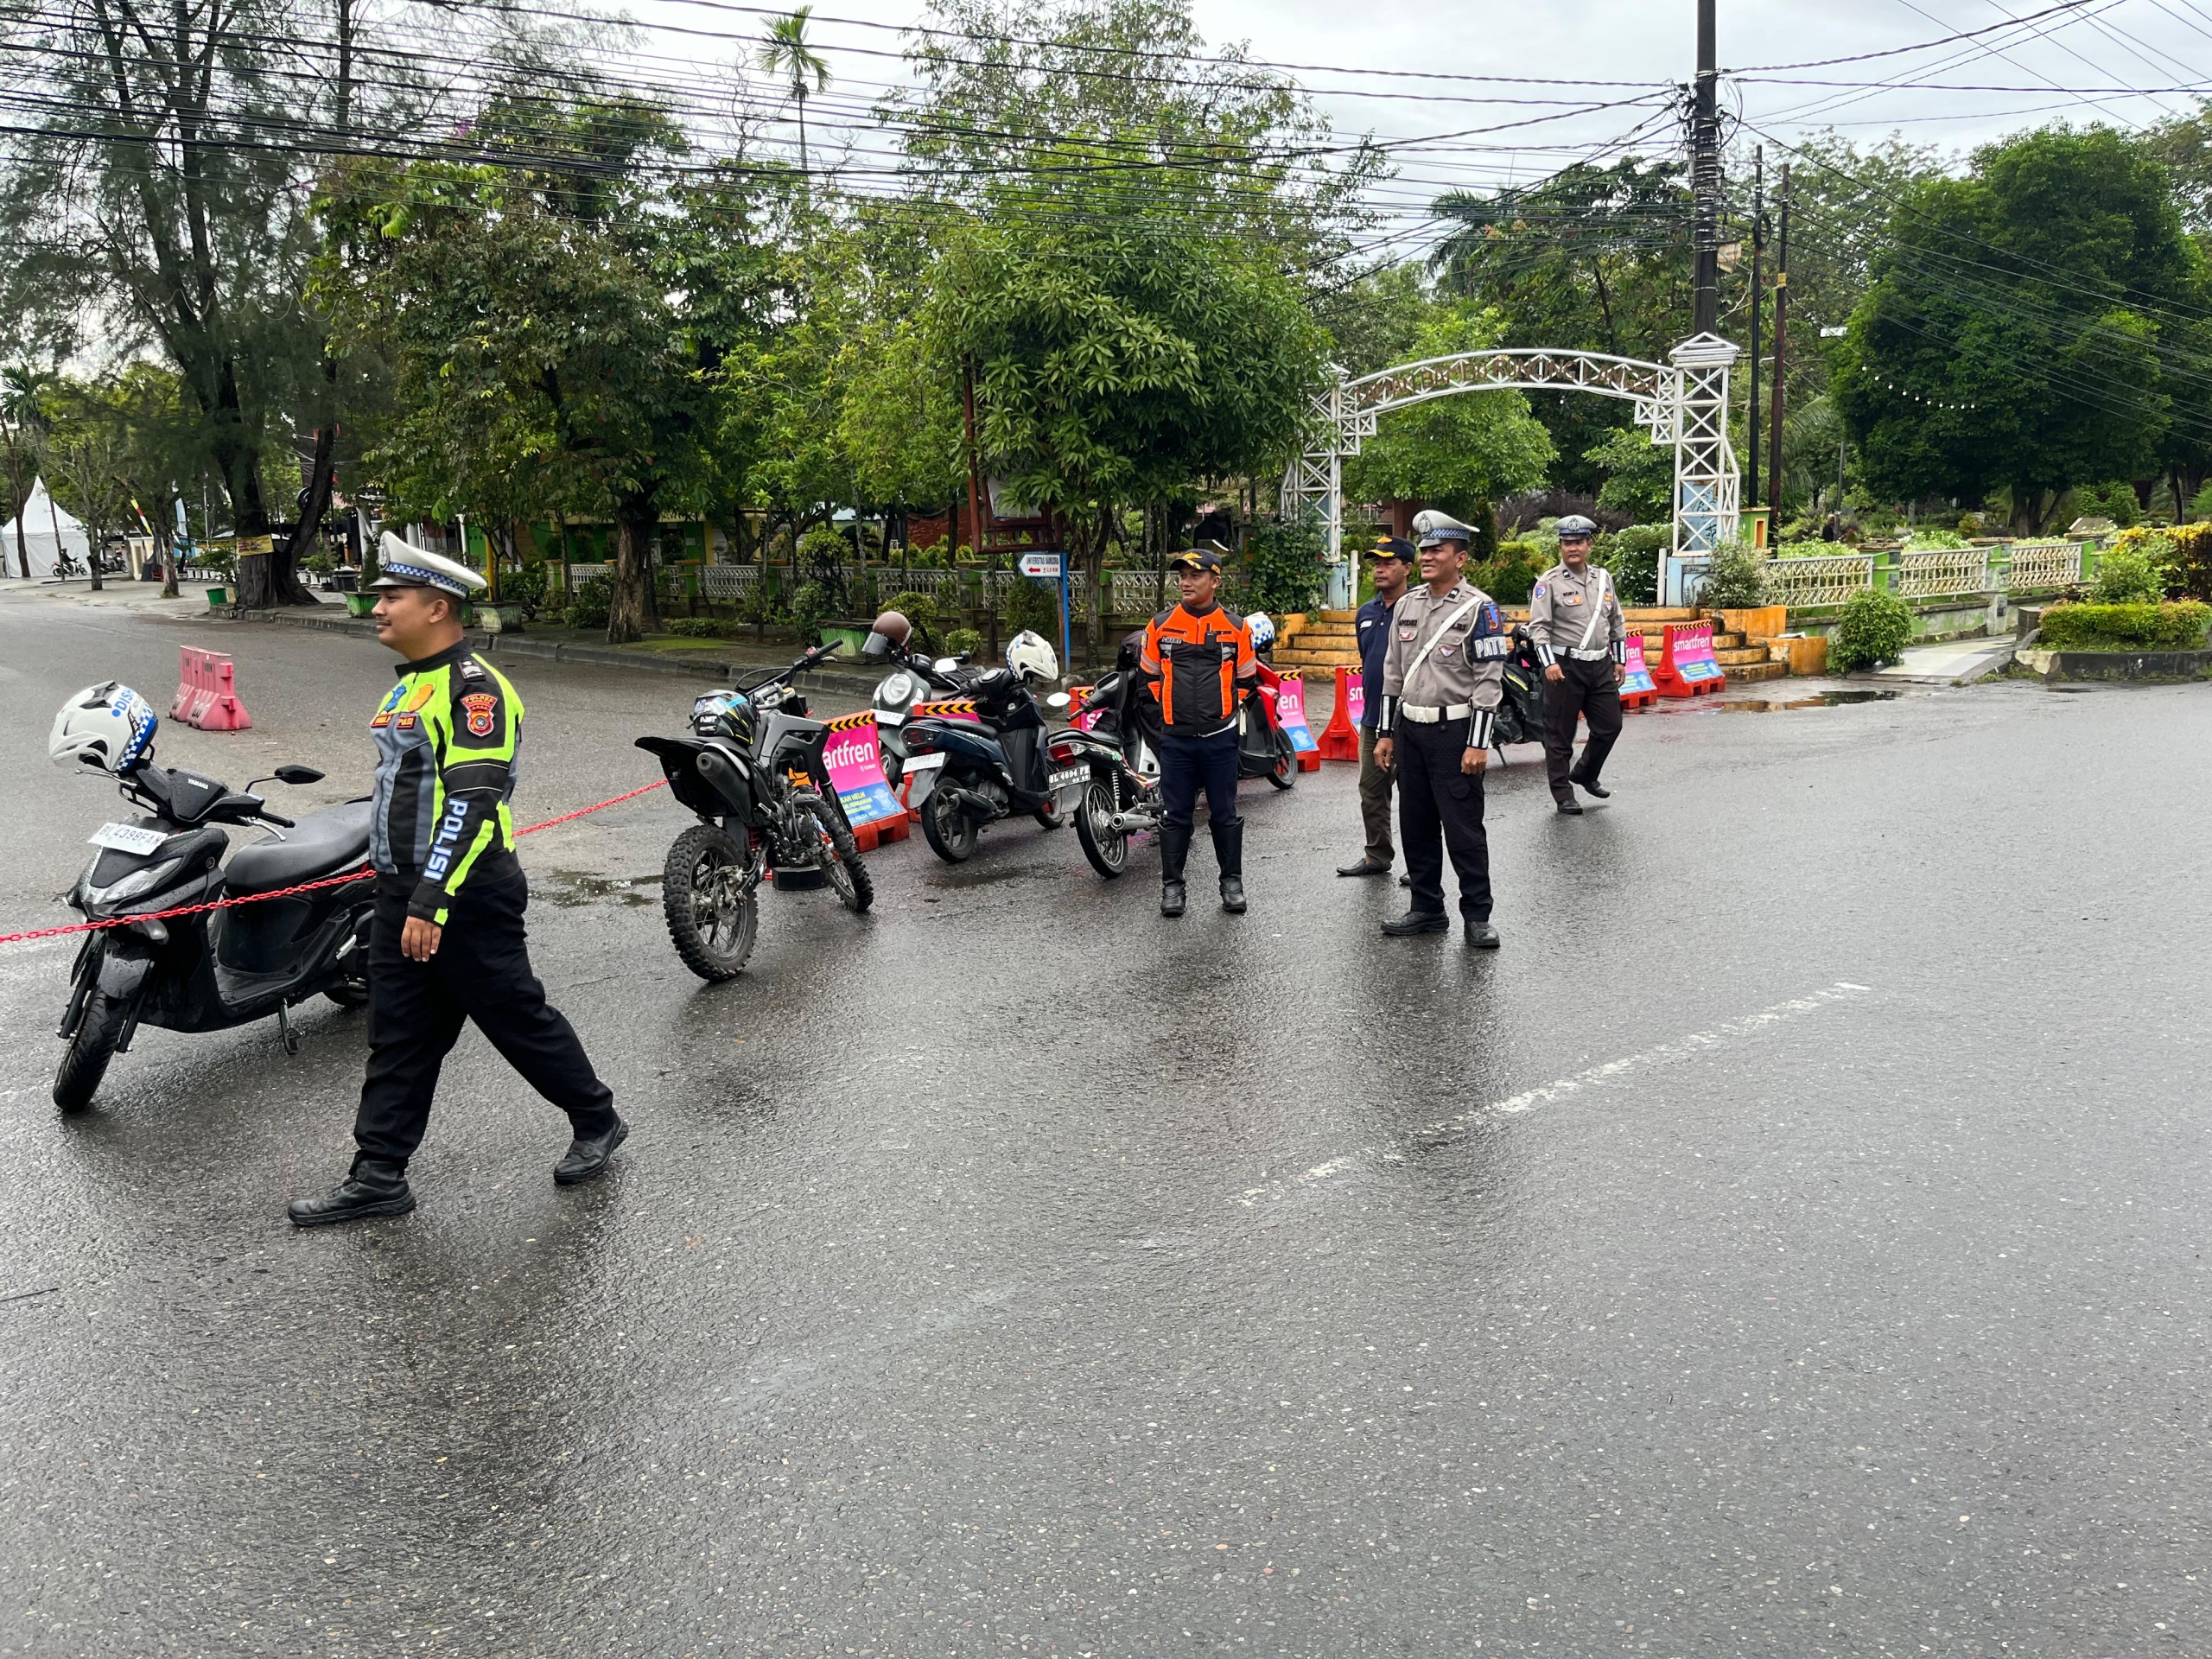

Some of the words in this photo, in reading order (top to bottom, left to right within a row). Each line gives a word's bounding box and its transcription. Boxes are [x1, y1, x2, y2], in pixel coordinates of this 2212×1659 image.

[1492, 358, 1576, 380] RUNCING
[1584, 363, 1660, 394] LANGSA
[1674, 634, 1709, 652] smartfren
[822, 740, 874, 771] artfren
[188, 779, 209, 790] YAMAHA
[423, 798, 469, 881] POLISI
